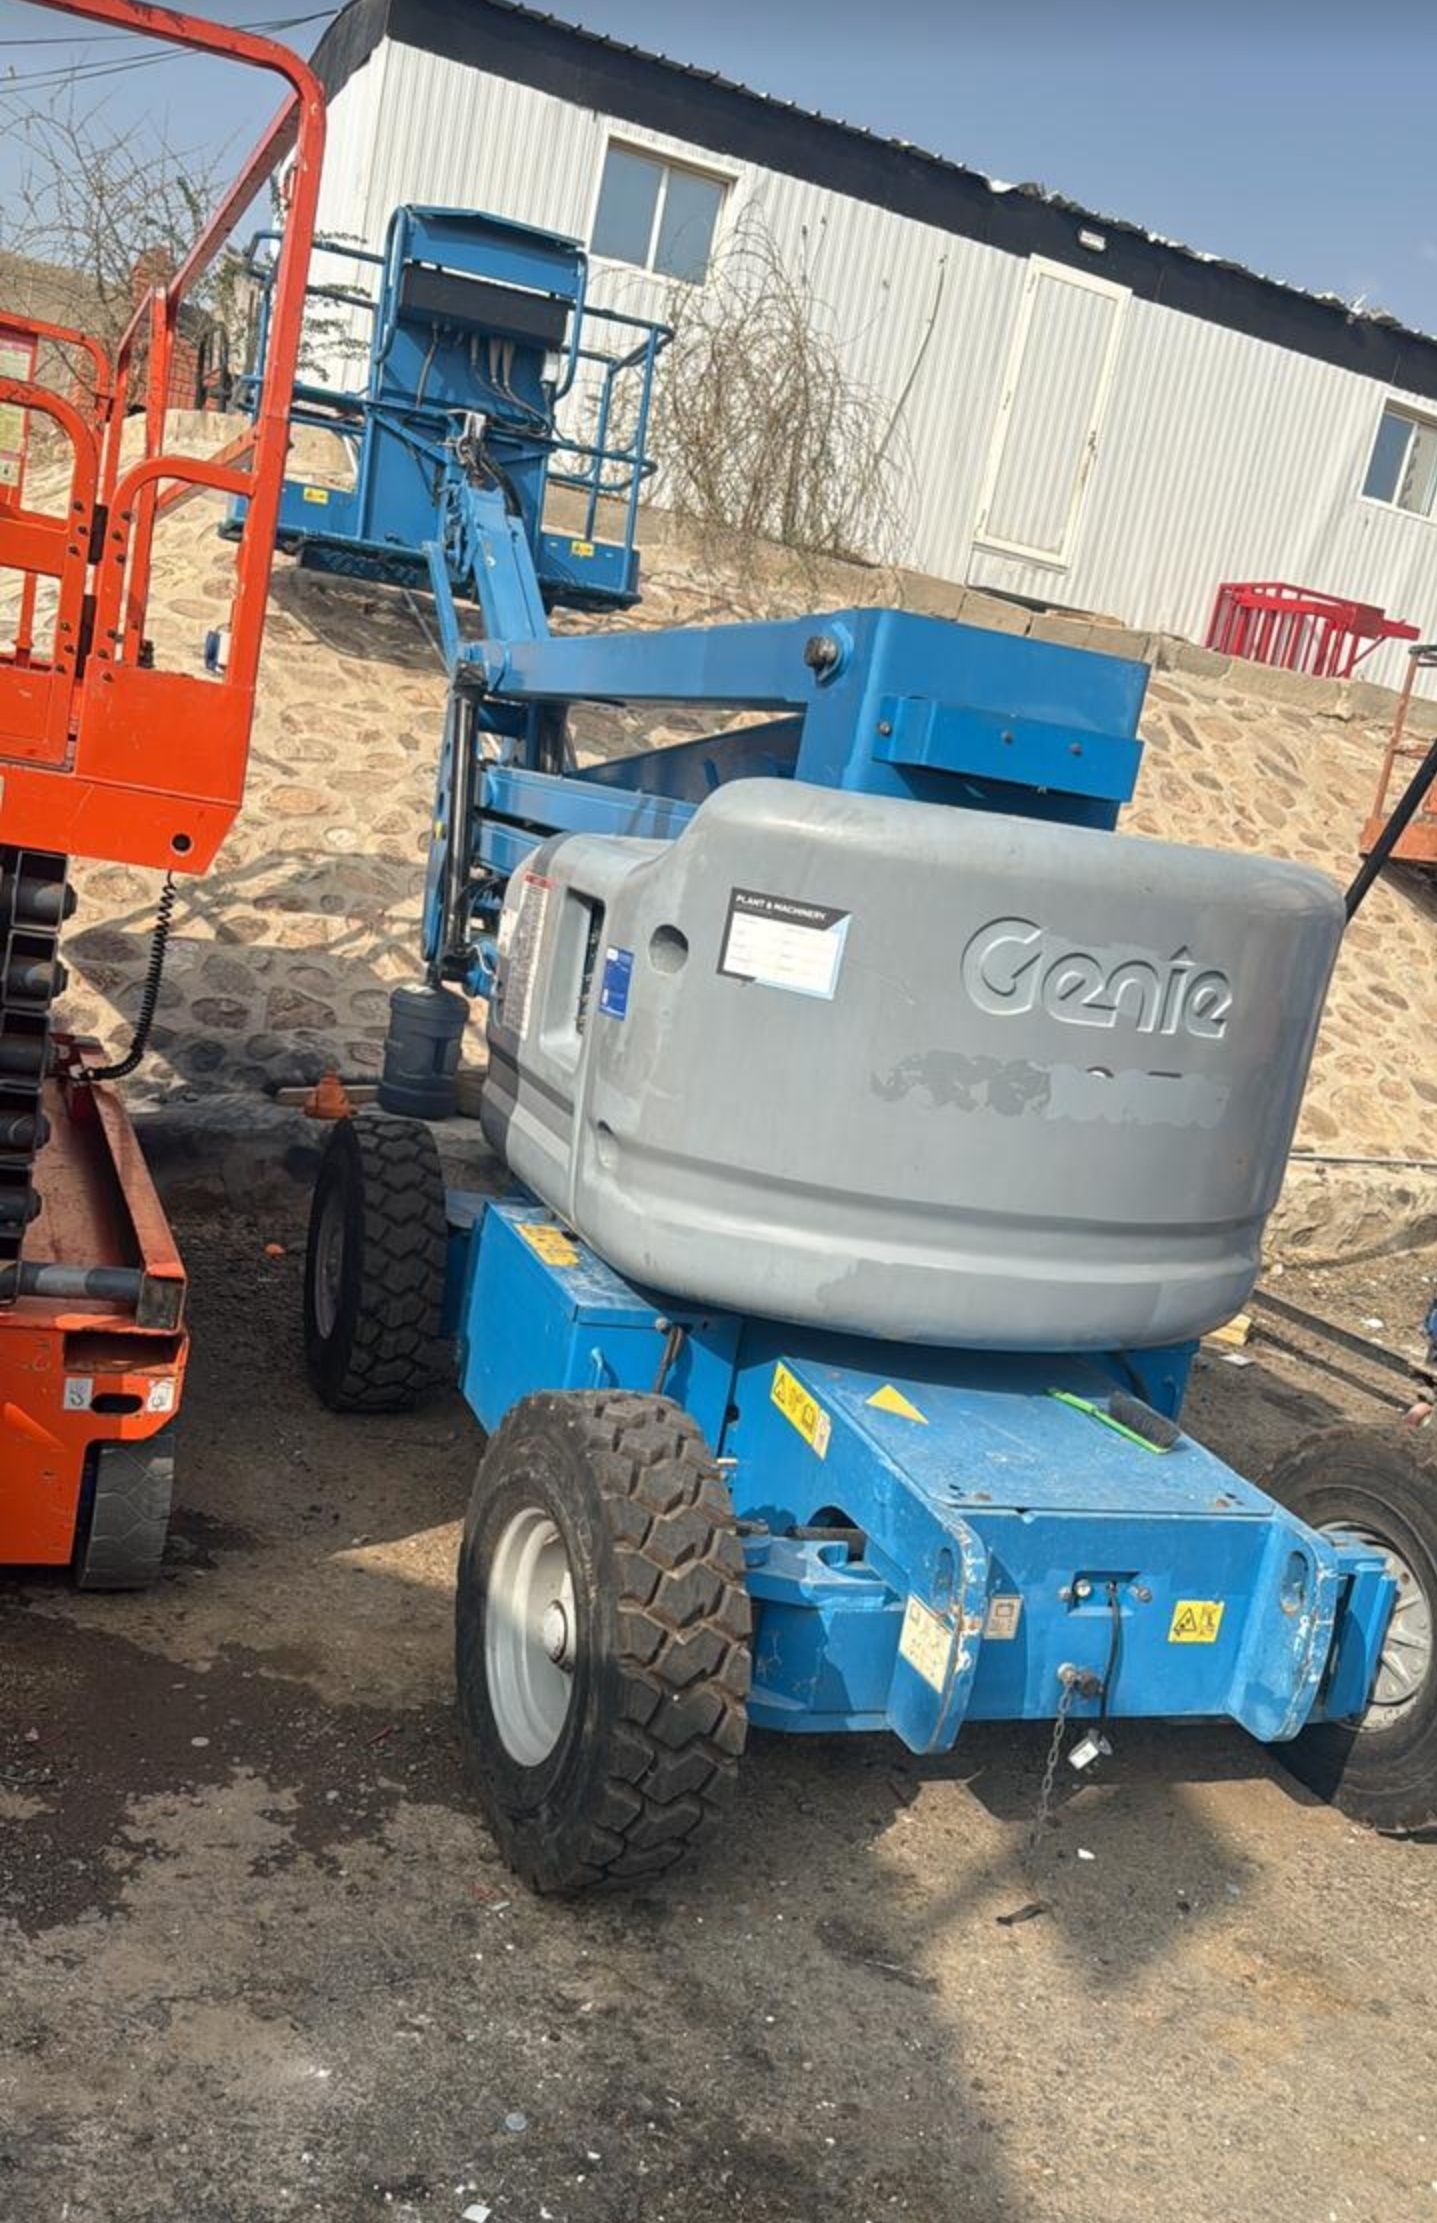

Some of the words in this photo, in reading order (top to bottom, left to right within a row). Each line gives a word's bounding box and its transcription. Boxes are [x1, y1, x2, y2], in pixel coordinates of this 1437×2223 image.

[735, 894, 765, 907] PLANT
[773, 903, 826, 920] MACHINERY
[960, 916, 1232, 1038] Genie
